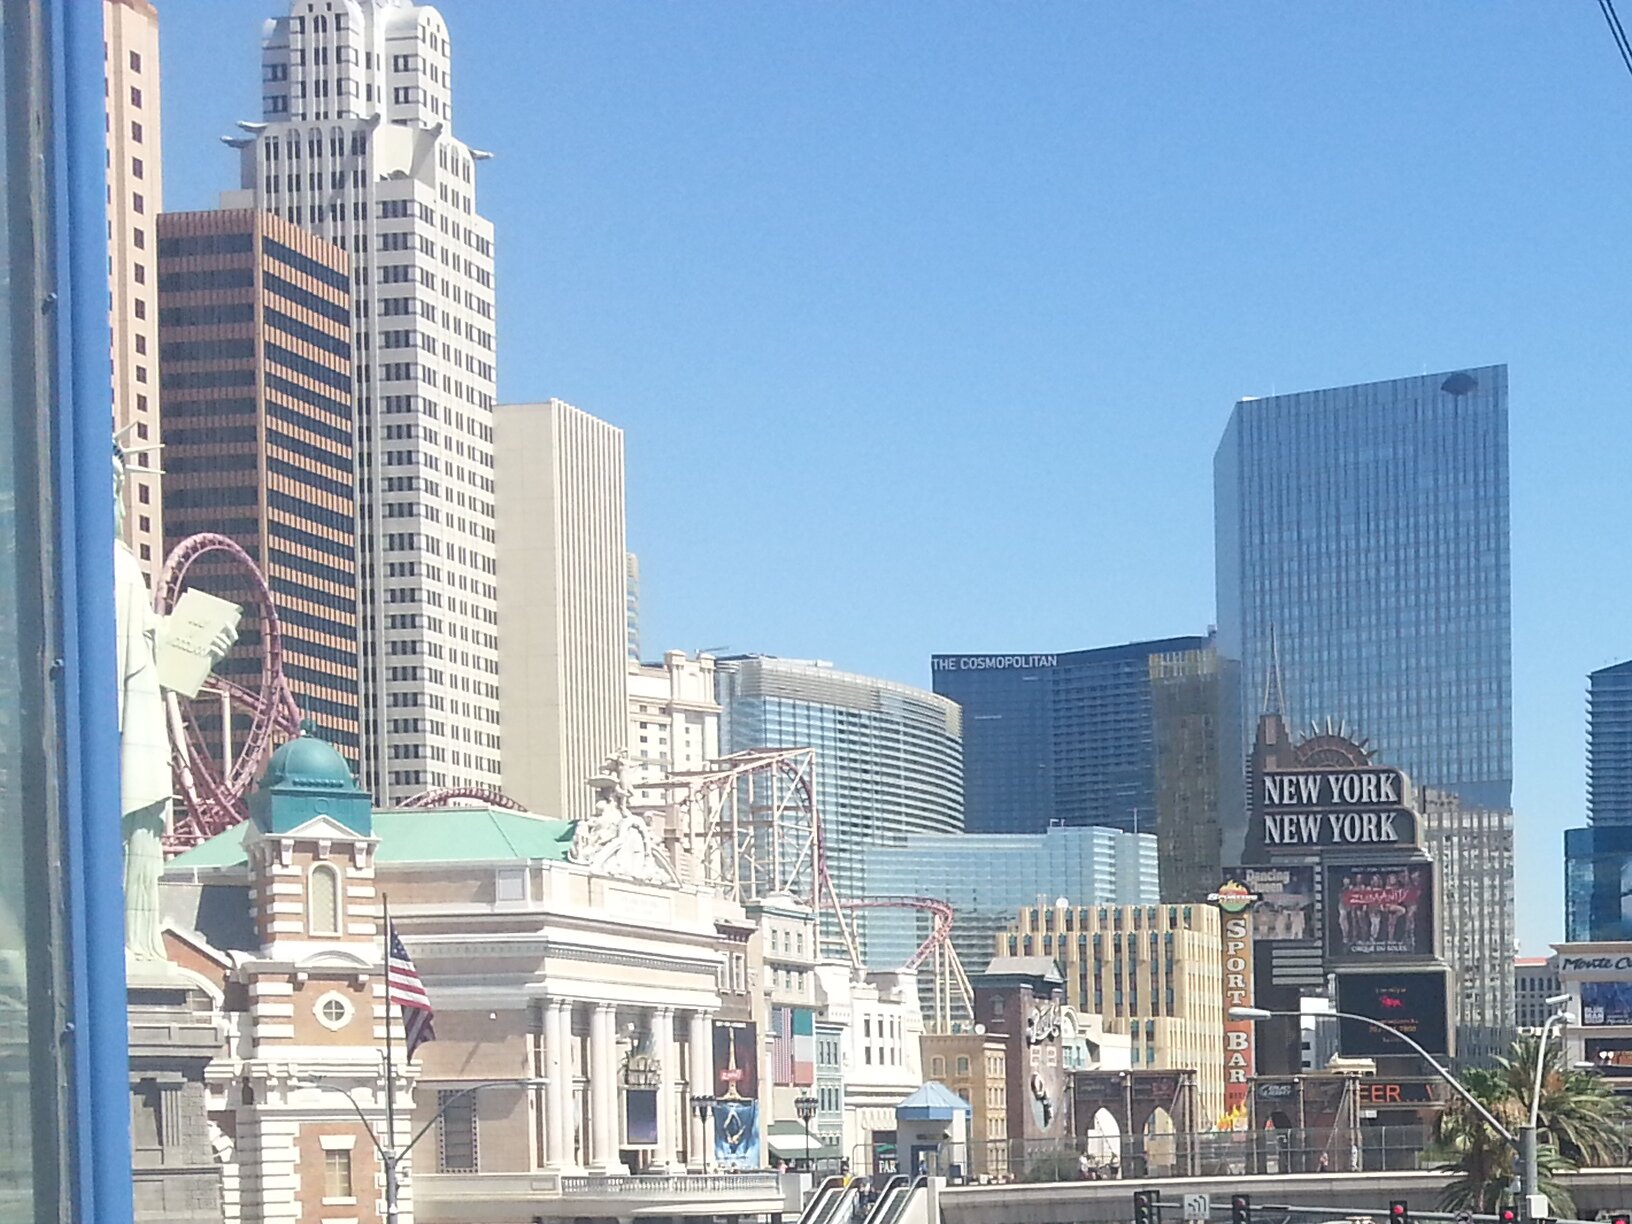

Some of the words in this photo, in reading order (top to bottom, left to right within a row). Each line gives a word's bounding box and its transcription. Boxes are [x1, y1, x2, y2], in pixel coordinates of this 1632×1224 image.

[932, 657, 957, 671] THE
[960, 655, 1057, 670] COSMOPOLITAN
[1264, 774, 1321, 805] NEW
[1327, 773, 1399, 804] YORK
[1264, 814, 1322, 844] NEW
[1328, 812, 1399, 843] YORK
[1226, 919, 1248, 1005] SPORT
[1562, 957, 1613, 971] Monte
[1227, 1031, 1249, 1083] BAR
[1360, 1084, 1401, 1102] EER
